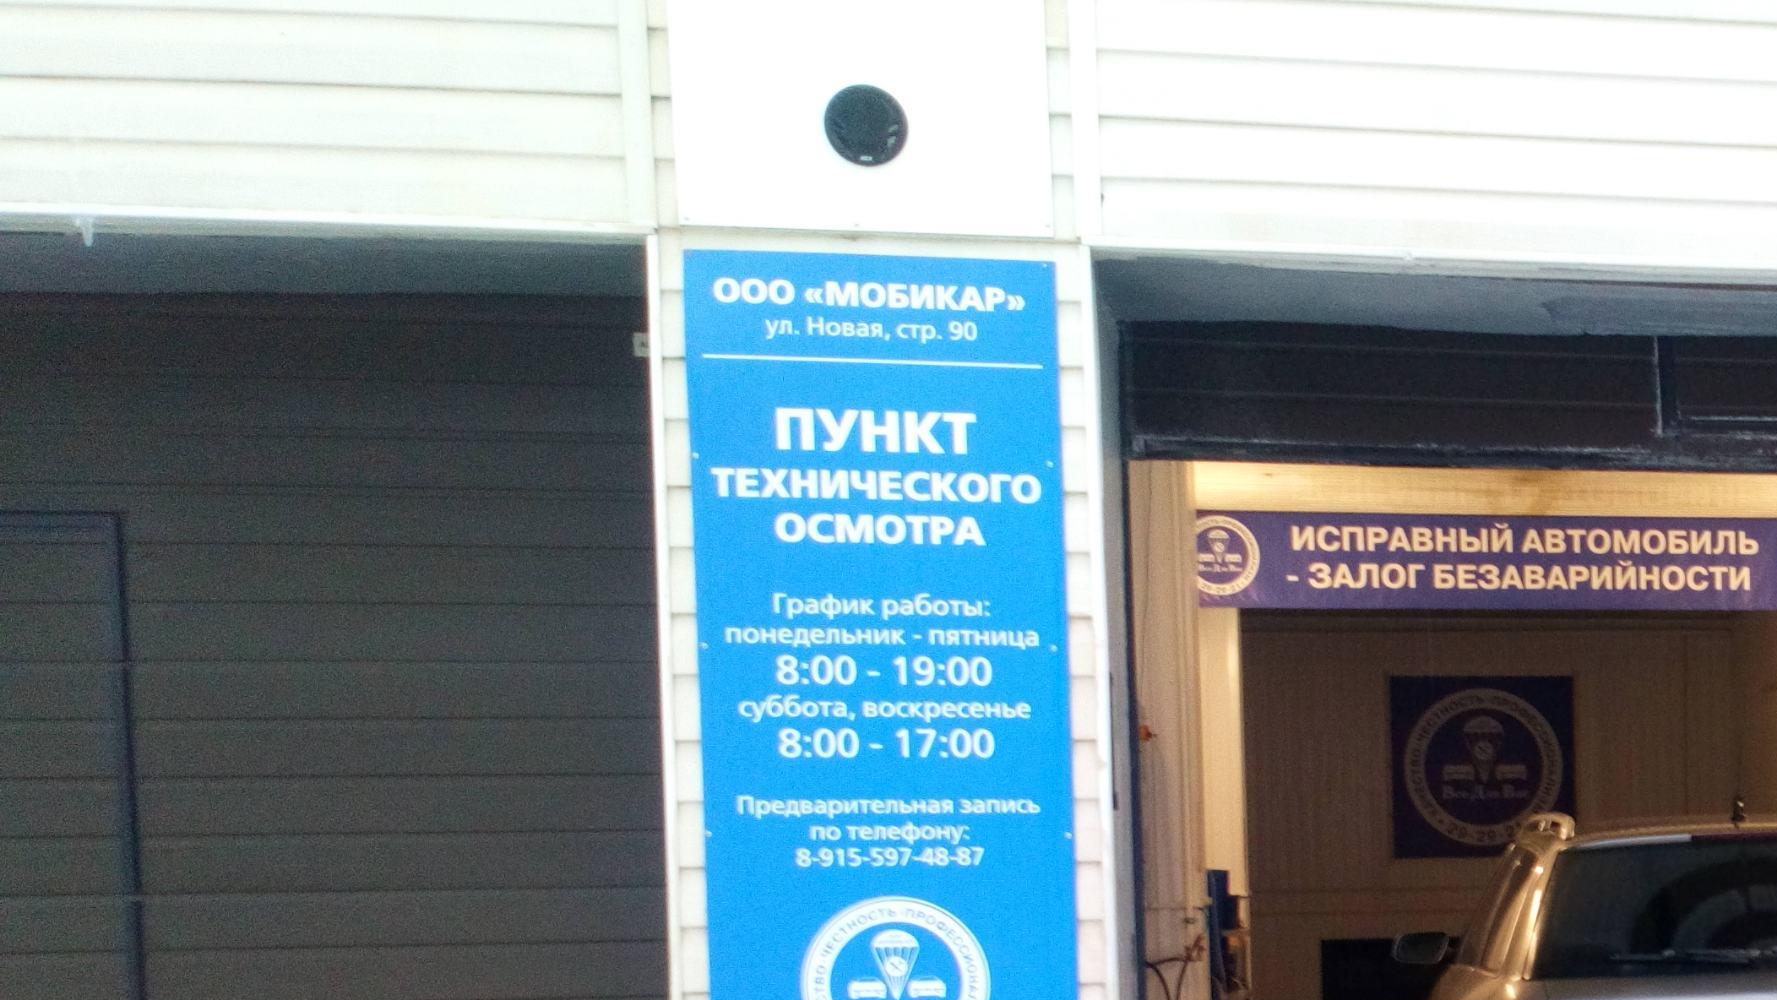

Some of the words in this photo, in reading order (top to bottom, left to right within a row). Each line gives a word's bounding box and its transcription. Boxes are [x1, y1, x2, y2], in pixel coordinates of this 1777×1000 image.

[712, 277, 795, 305] ООО
[804, 281, 1025, 312] «МОБИКАР»
[765, 319, 799, 339] ул.
[806, 316, 890, 341] Новая,
[895, 323, 942, 344] стр.
[948, 320, 977, 340] 90
[774, 407, 976, 454] ПУНКТ
[710, 467, 1041, 504] ТЕХНИЧЕСКОГО
[774, 512, 985, 546] ОСМОТРА
[1291, 523, 1513, 552] ИСПРАВНЫЙ
[1522, 529, 1759, 555] АВТОМОБИЛЬ
[1308, 562, 1425, 589] ЗАЛОГ
[1435, 560, 1750, 591] БЕЗАВАРИЙНОСТИ
[772, 592, 875, 620] График
[881, 593, 990, 620] работы:
[725, 627, 905, 647] понедельник
[928, 629, 1039, 649] пятница
[775, 654, 857, 685] 8:00
[893, 656, 992, 686] 19:00
[738, 694, 855, 723] суббота,
[862, 701, 1031, 722] воскресенье
[778, 728, 859, 758] 8:00
[896, 728, 994, 759] 17:00
[736, 795, 953, 819] Предварительная
[959, 799, 1040, 814] запись
[809, 826, 841, 840] по
[846, 822, 969, 845] телефону:
[795, 847, 985, 868] 8-915-597-48-87
